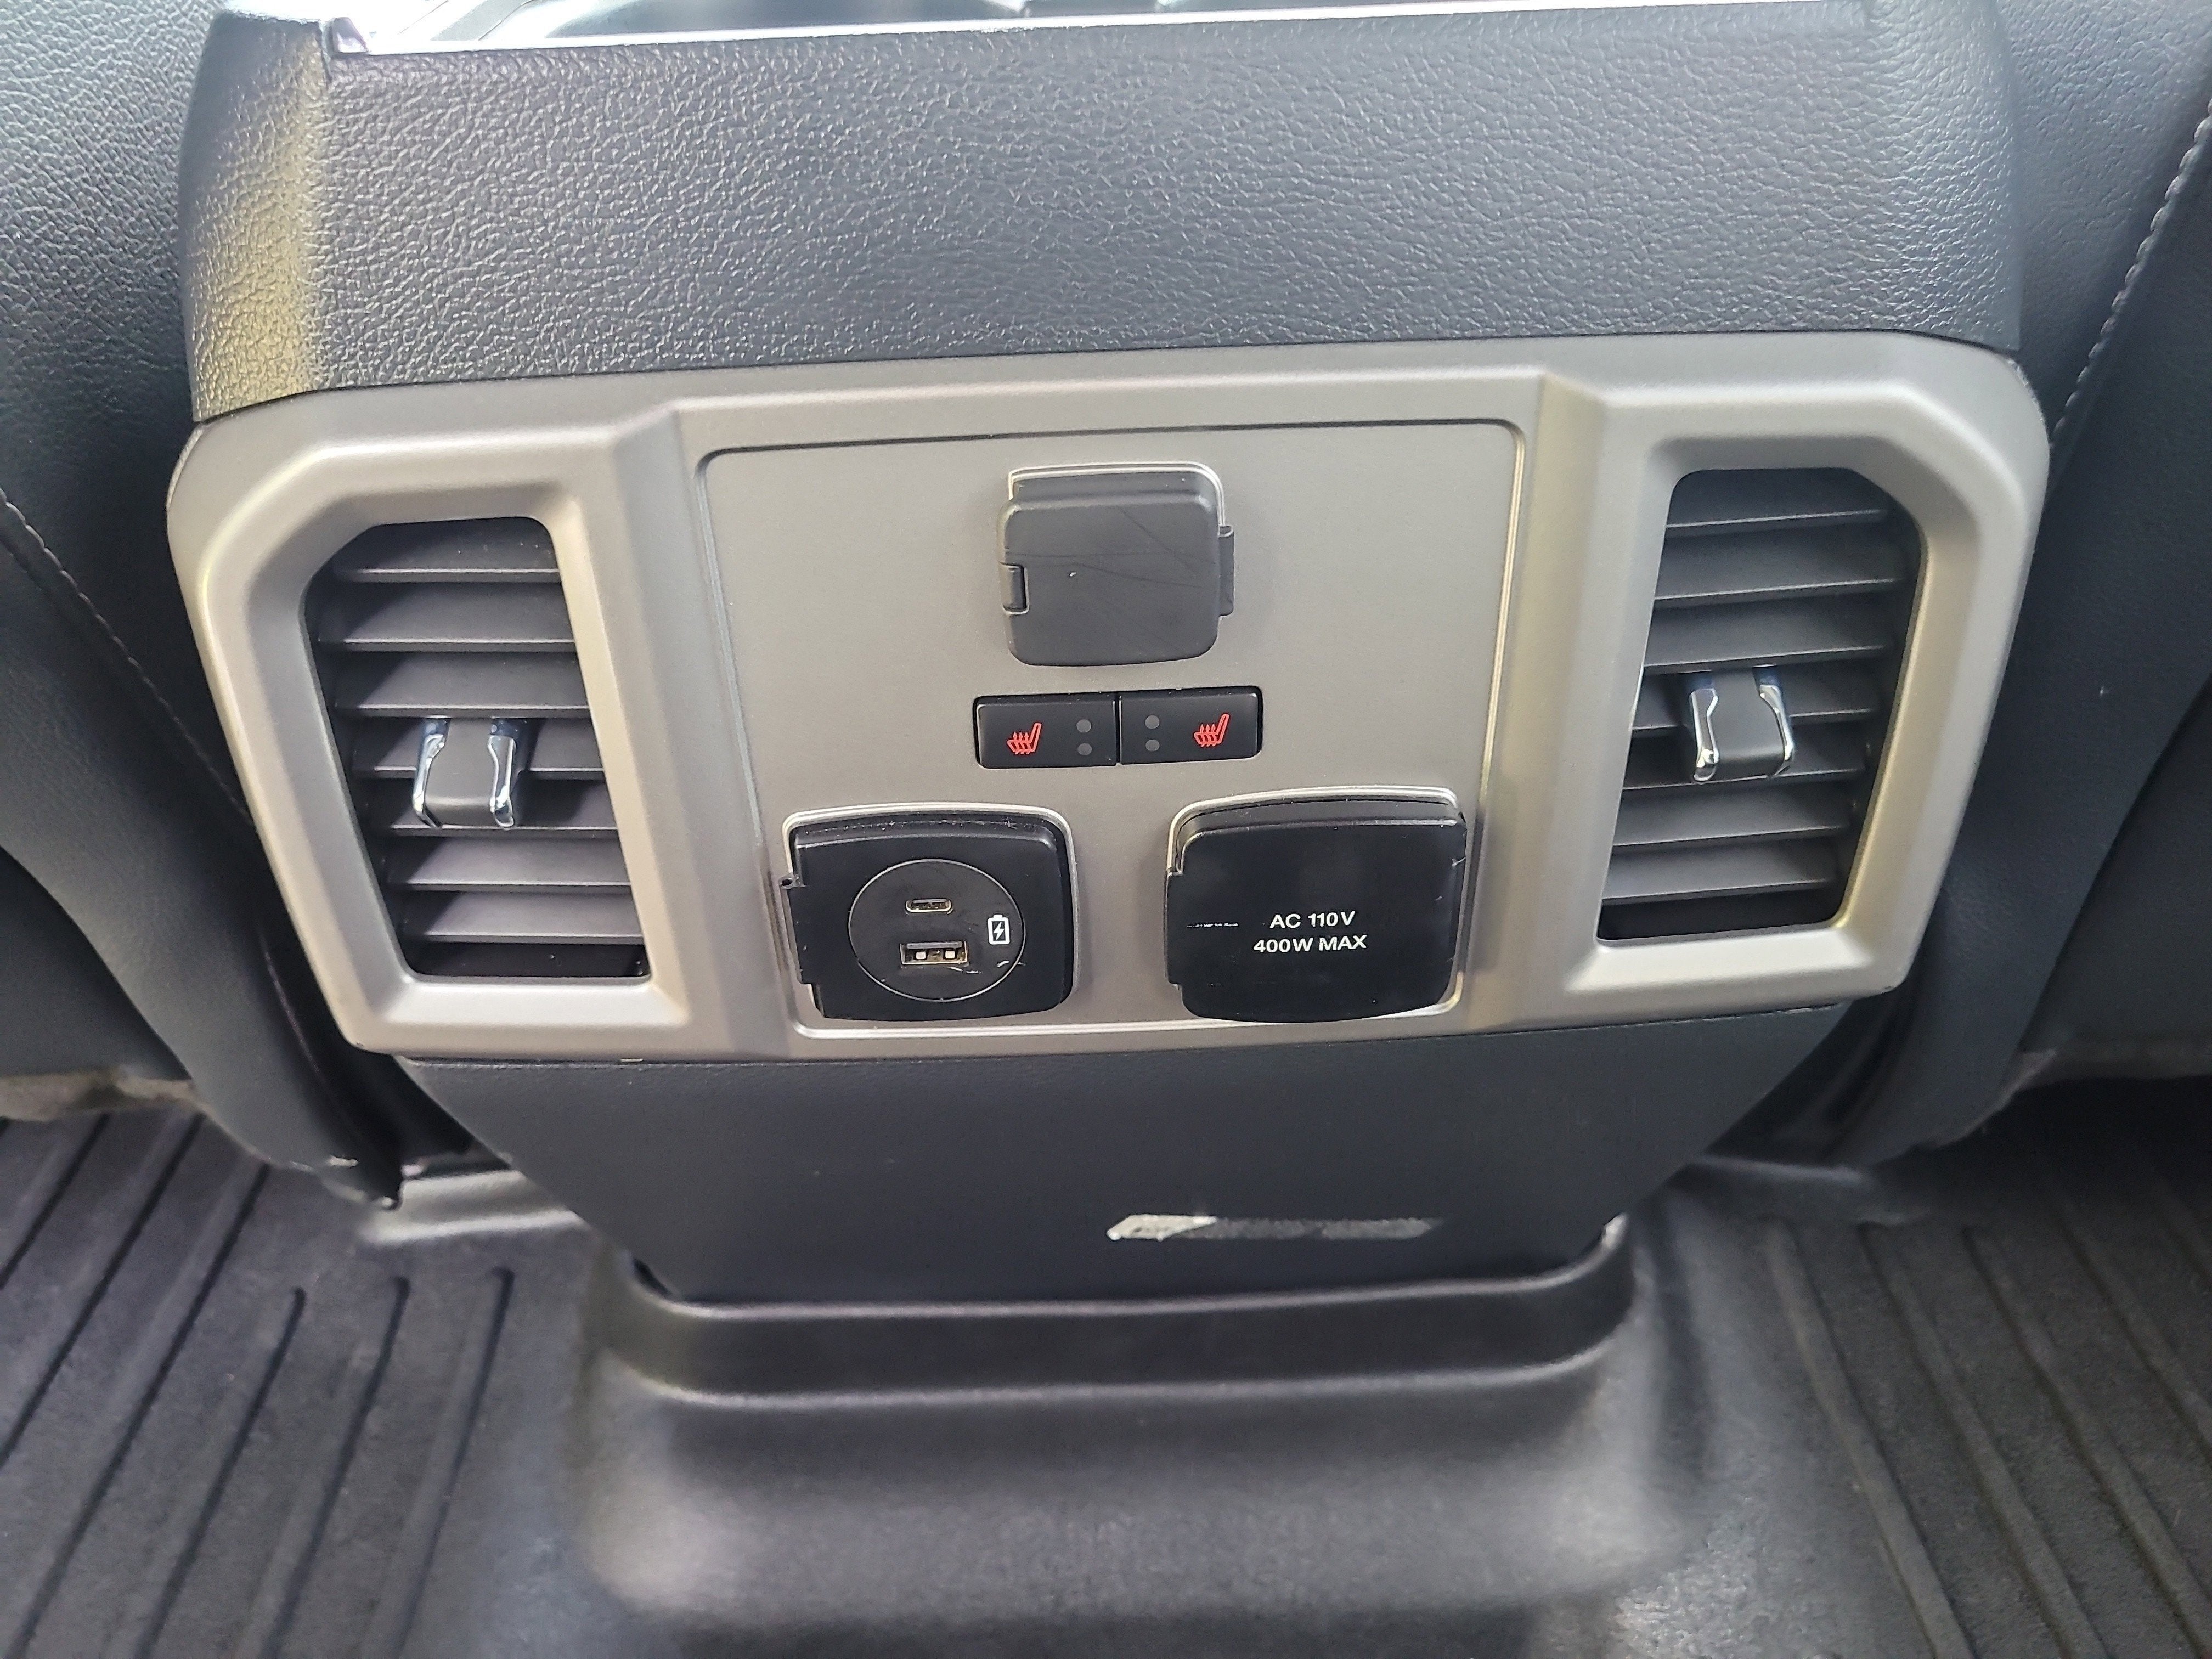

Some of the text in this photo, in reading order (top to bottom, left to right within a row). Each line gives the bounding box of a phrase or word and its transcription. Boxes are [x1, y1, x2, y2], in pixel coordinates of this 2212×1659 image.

[1269, 911, 1356, 929] AC 110V
[1253, 934, 1367, 953] 400W MAX
